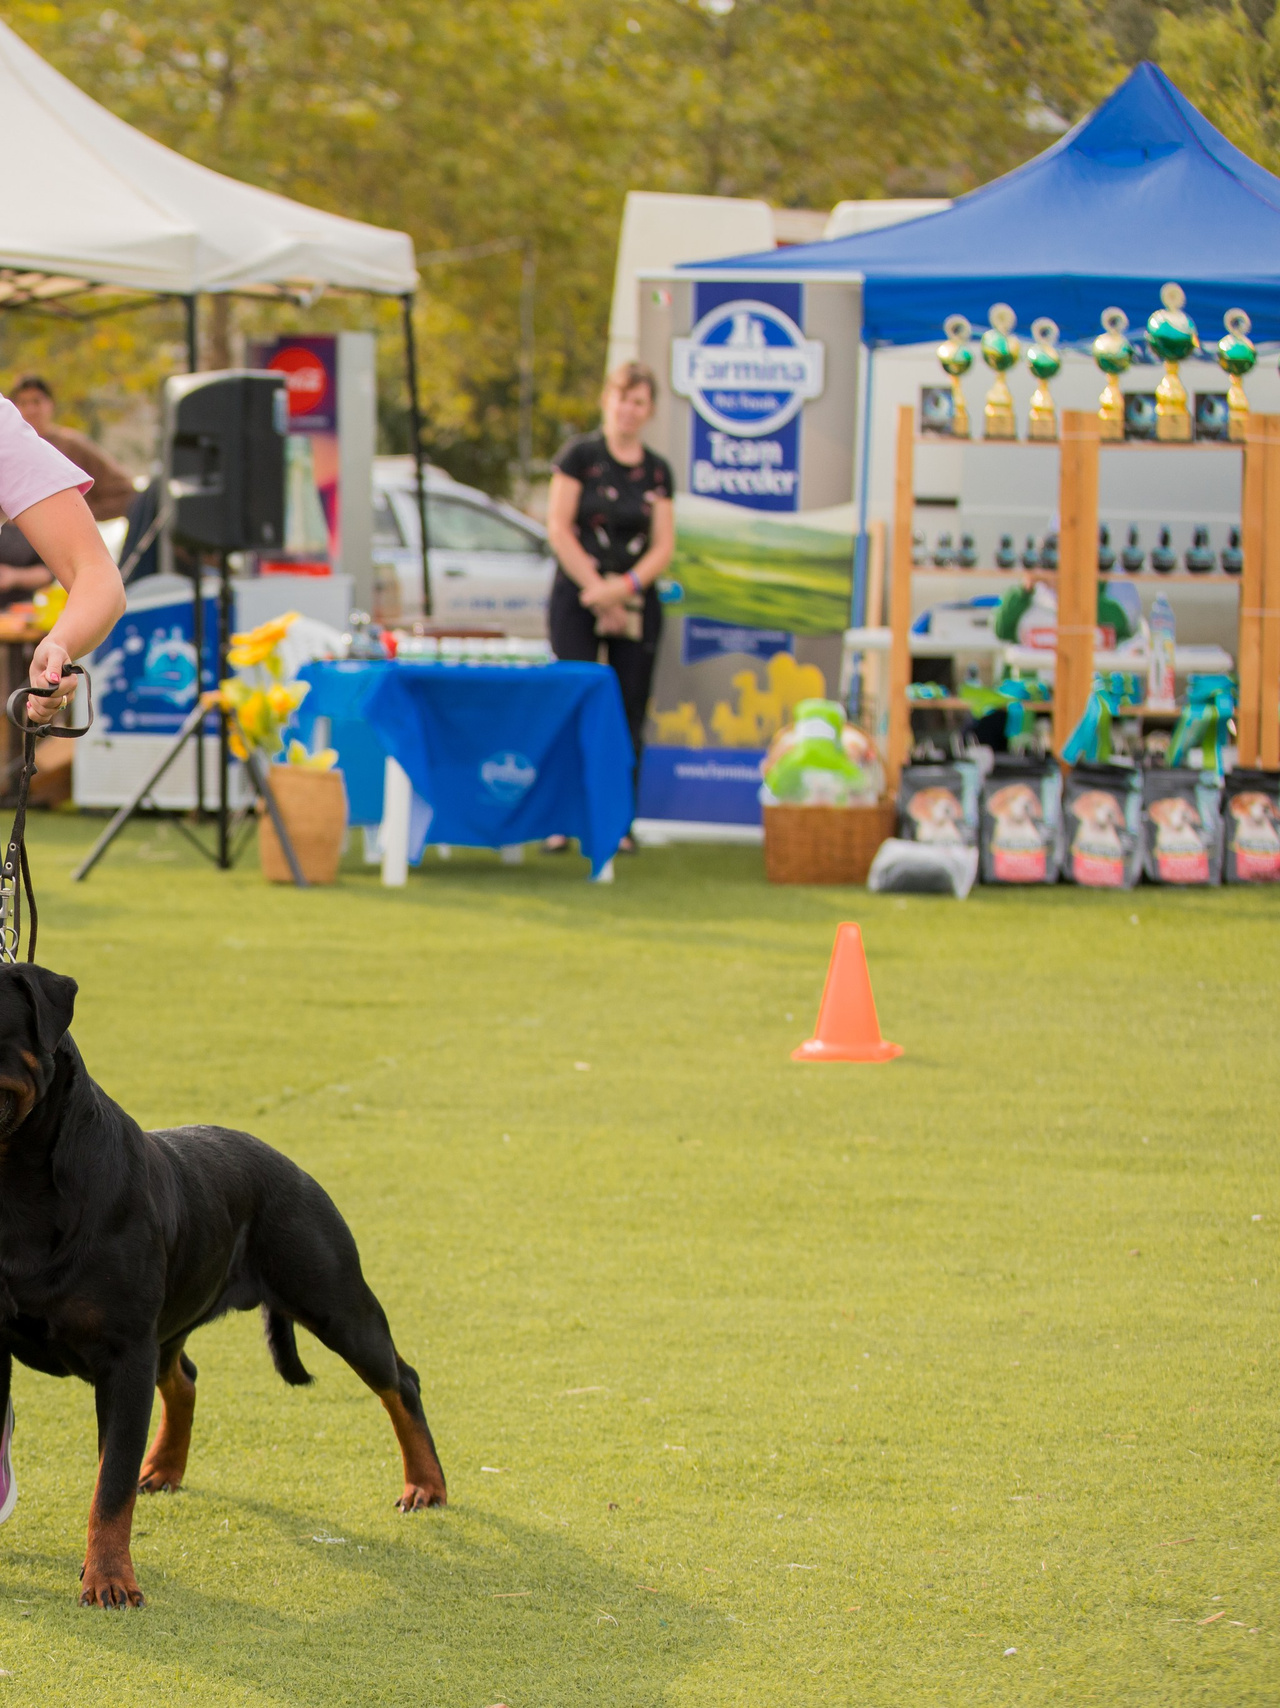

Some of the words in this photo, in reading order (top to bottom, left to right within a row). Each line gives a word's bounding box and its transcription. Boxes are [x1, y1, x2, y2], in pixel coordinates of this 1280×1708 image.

[688, 351, 808, 382] Farmina
[707, 431, 783, 467] Team
[693, 460, 798, 495] Breeder
